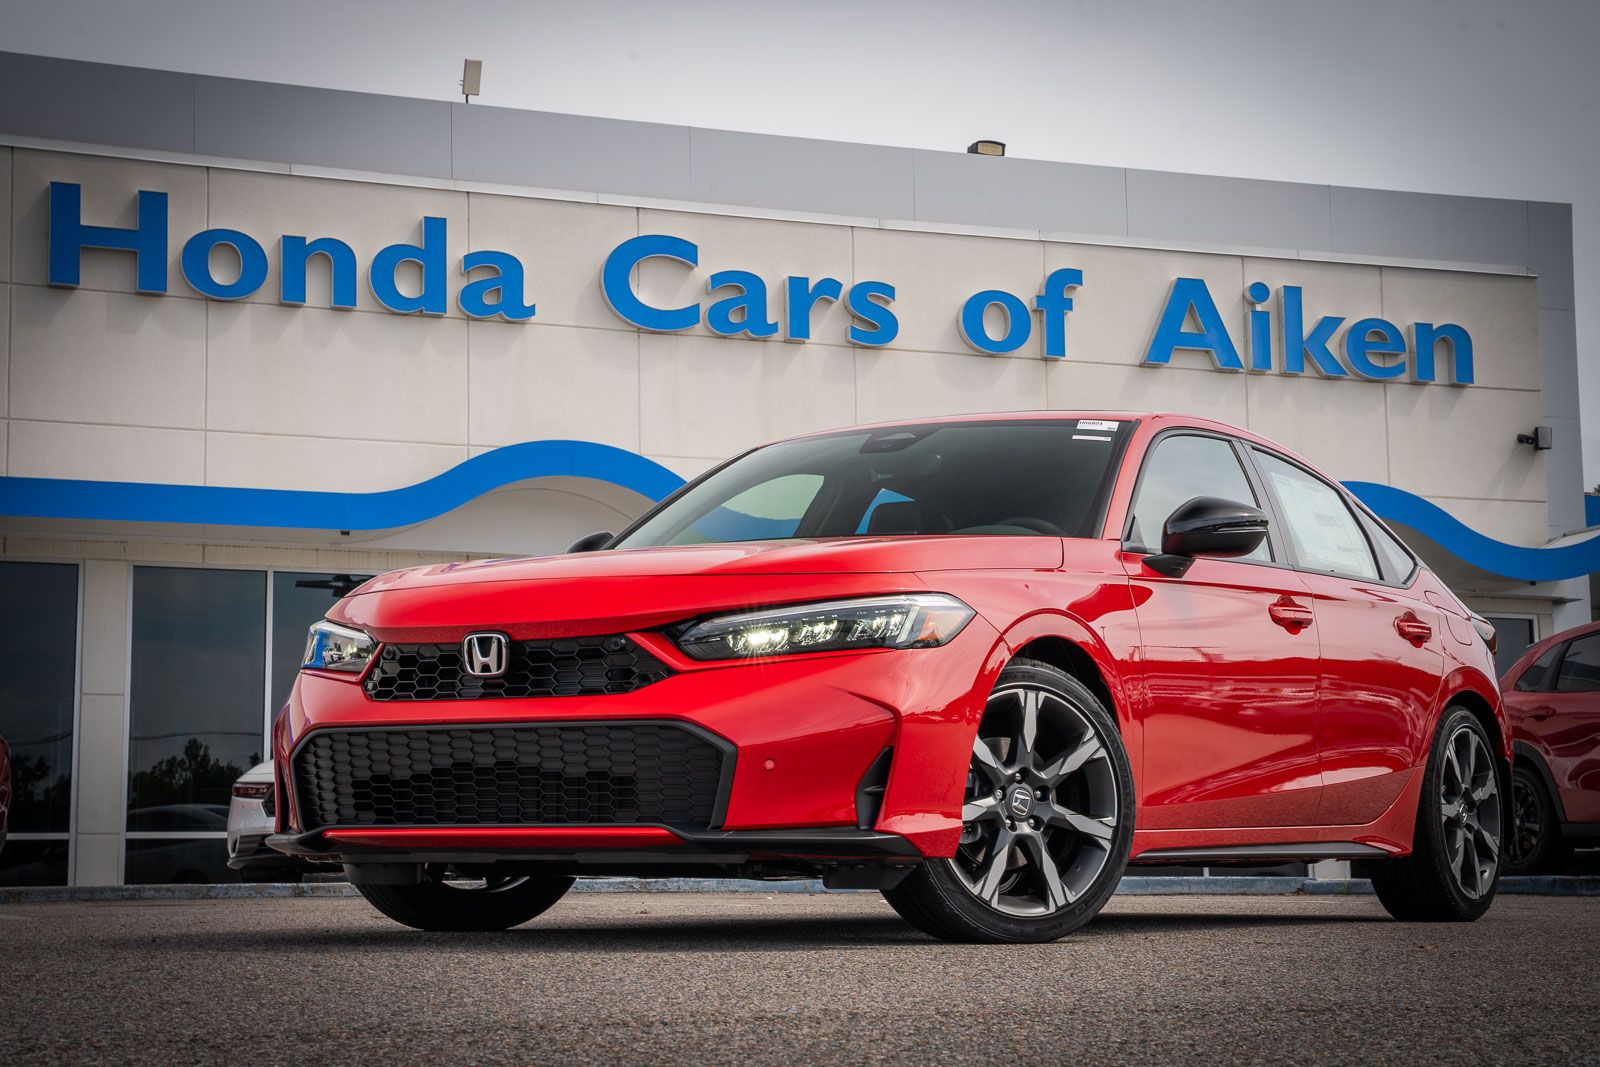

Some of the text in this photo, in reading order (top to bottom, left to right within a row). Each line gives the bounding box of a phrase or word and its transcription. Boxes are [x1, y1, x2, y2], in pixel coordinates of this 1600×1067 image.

[48, 181, 1475, 386] Honda Cars of Aiken
